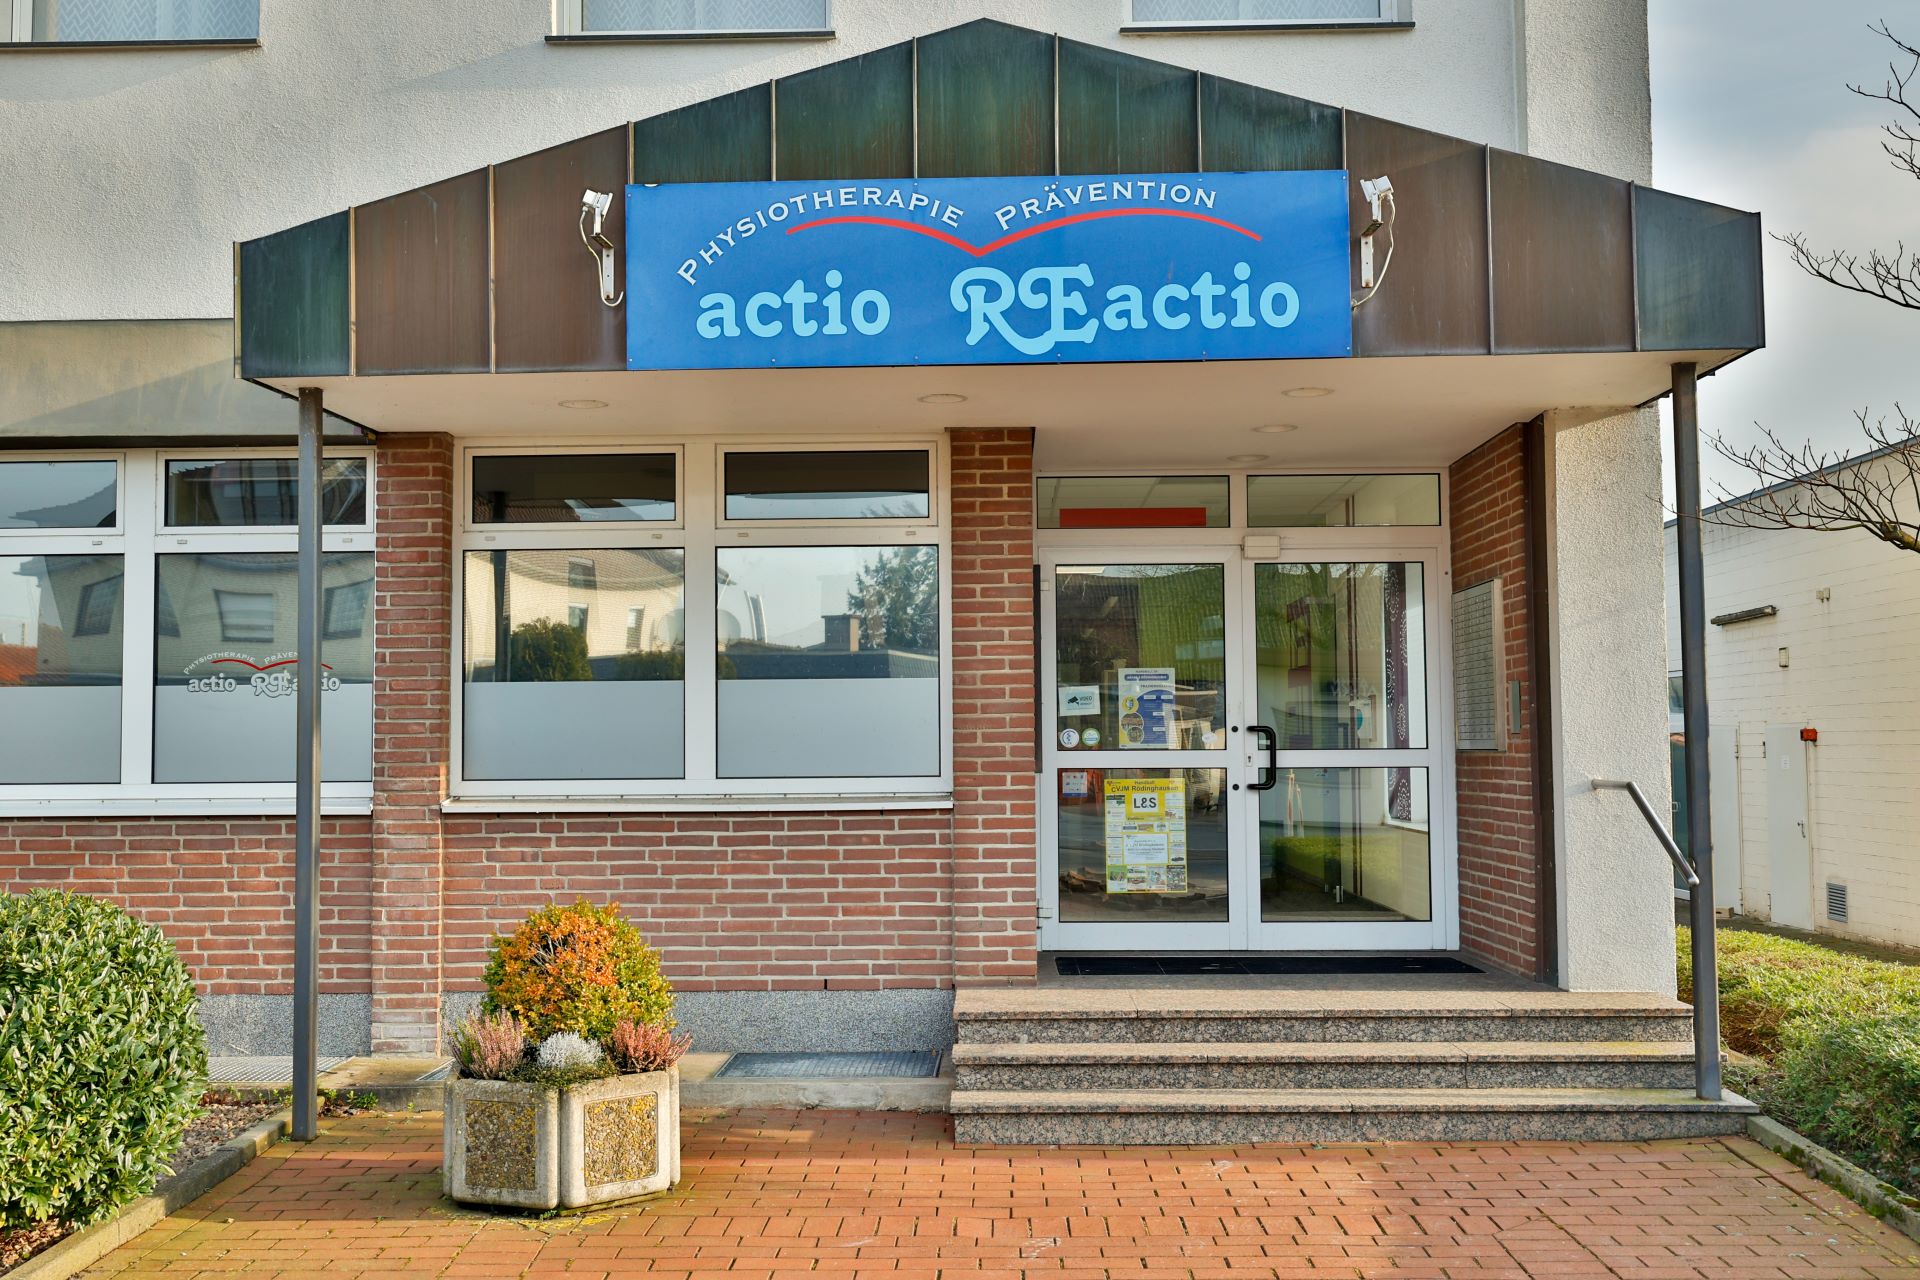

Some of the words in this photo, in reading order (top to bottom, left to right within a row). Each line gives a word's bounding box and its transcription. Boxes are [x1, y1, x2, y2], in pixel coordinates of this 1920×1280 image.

[676, 187, 964, 286] PHYSIOTHERAPIE
[994, 181, 1217, 231] PRÄVENTION
[696, 269, 891, 339] actio
[949, 261, 1300, 356] REactio
[183, 651, 256, 675] PHYSIOTHERAPIE
[187, 673, 236, 692] actio
[1133, 797, 1157, 809] L&S
